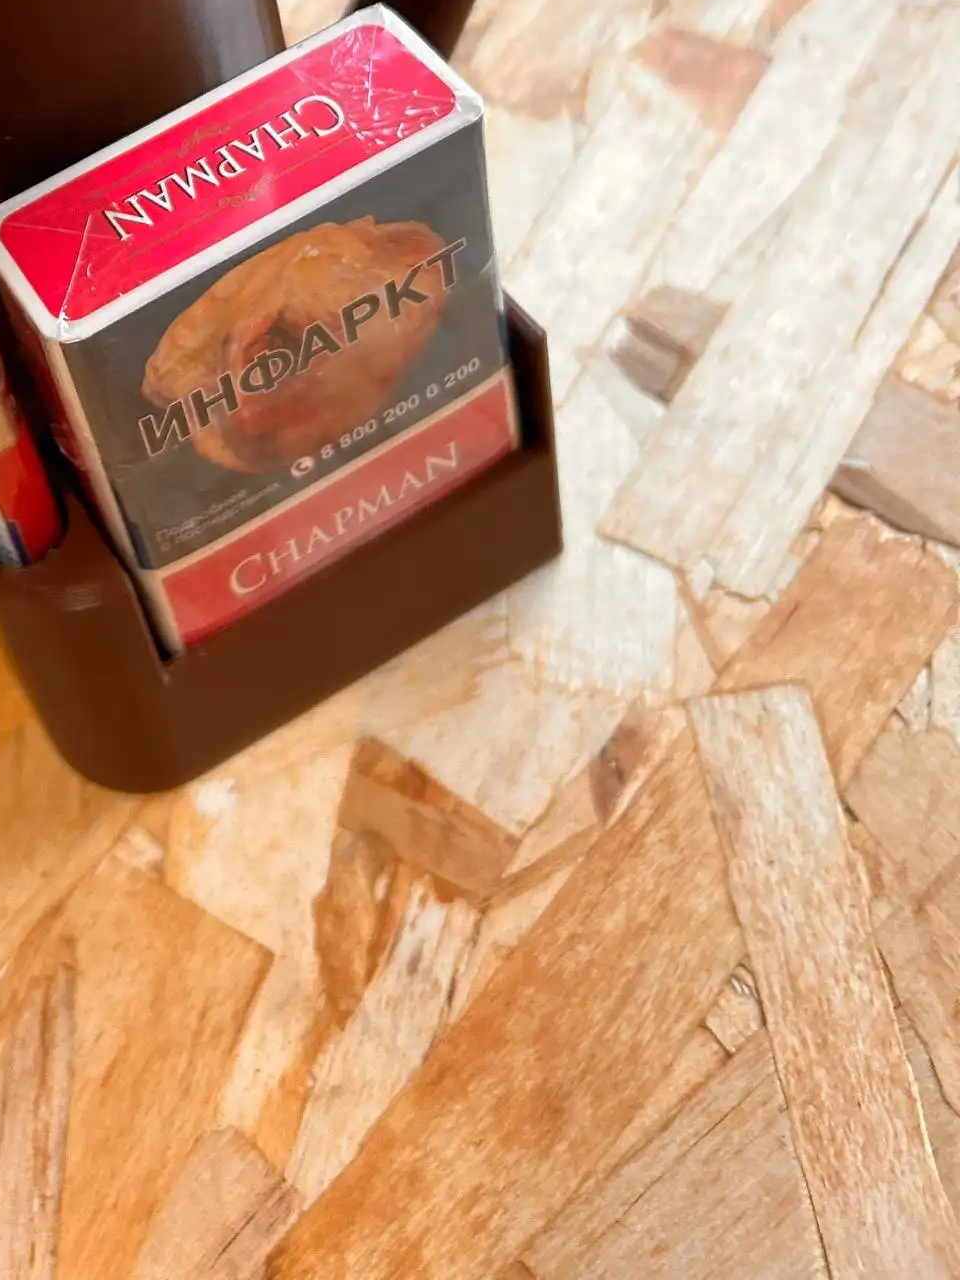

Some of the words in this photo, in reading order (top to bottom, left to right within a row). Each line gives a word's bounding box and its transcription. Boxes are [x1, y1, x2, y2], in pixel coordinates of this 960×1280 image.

[102, 94, 345, 241] CHAPMAN
[137, 237, 467, 458] ИНФАРКТ
[319, 442, 336, 461] 8
[340, 418, 378, 450] 800
[382, 393, 421, 424] 200
[424, 382, 439, 400] 0
[443, 356, 481, 389] 200
[228, 440, 462, 596] CHAPMAN
